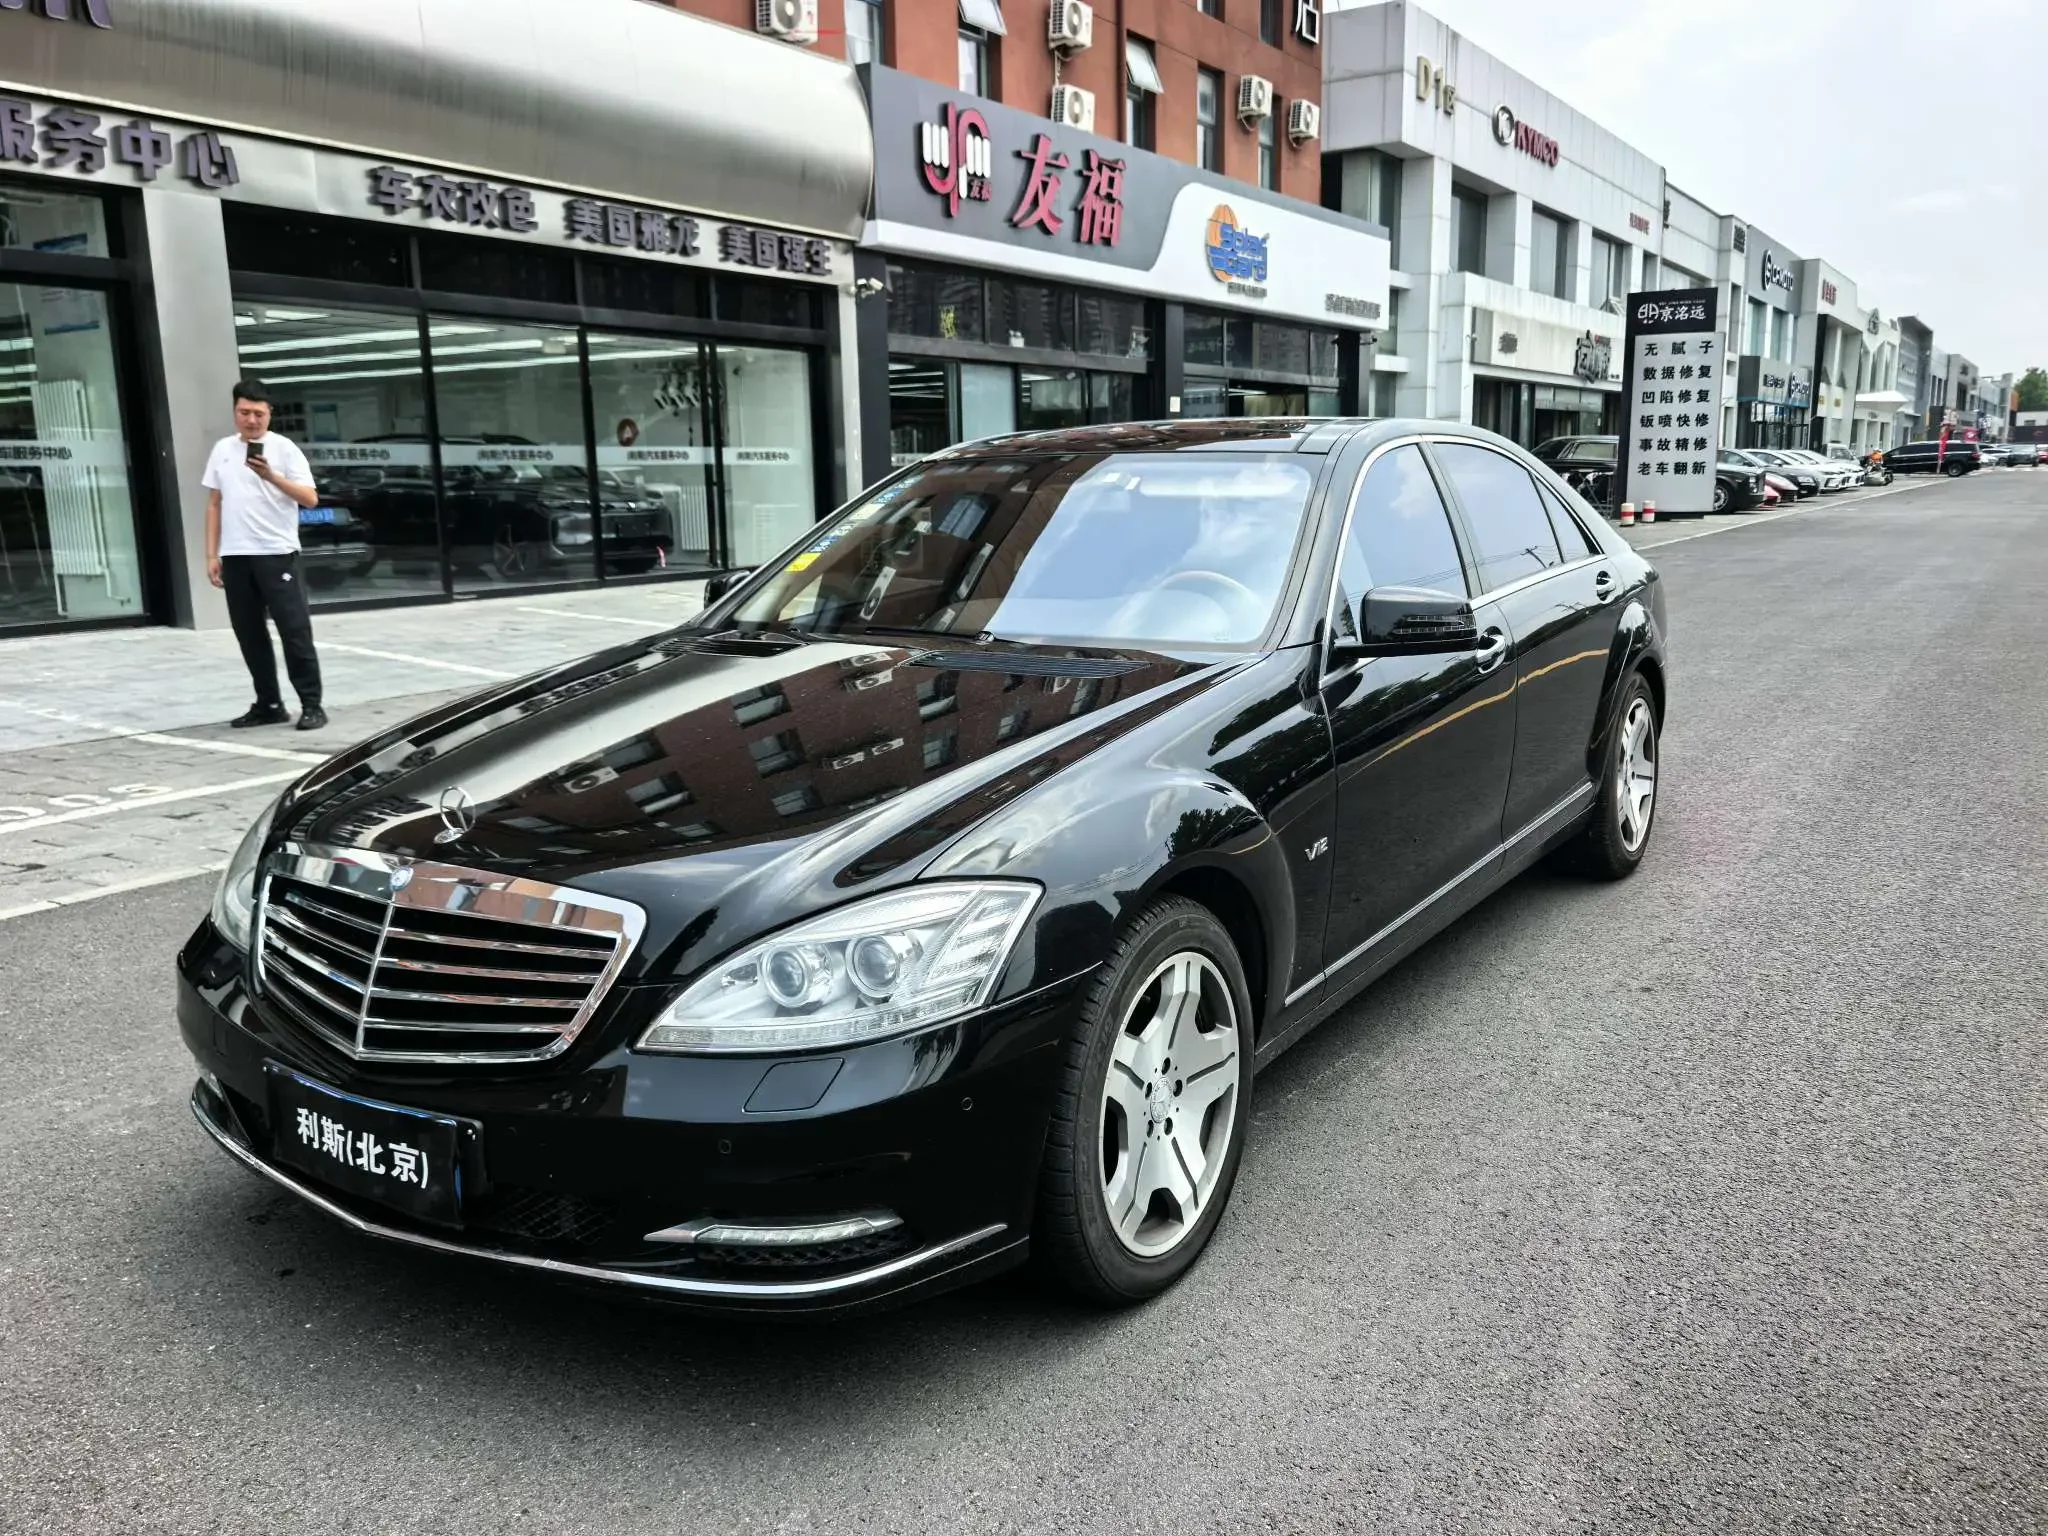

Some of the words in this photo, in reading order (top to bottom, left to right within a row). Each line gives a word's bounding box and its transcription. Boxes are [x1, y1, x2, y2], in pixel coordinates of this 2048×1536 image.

[0, 99, 239, 188] 服务中心
[1514, 121, 1559, 168] KYMCO
[1010, 133, 1127, 247] 友福
[370, 166, 539, 232] 车衣改色
[565, 200, 700, 257] 美国雅龙
[719, 226, 831, 275] 美国强生
[1644, 341, 1714, 356] 无腻子
[1643, 365, 1711, 380] 数据修复
[1642, 389, 1710, 404] 凹陷修复
[1640, 413, 1709, 428] 钣喷快修
[1639, 437, 1708, 452] 事故精修
[1638, 461, 1706, 476] 老车翻新
[1304, 836, 1328, 861] V12
[296, 1107, 428, 1189] 利斯(北京)
